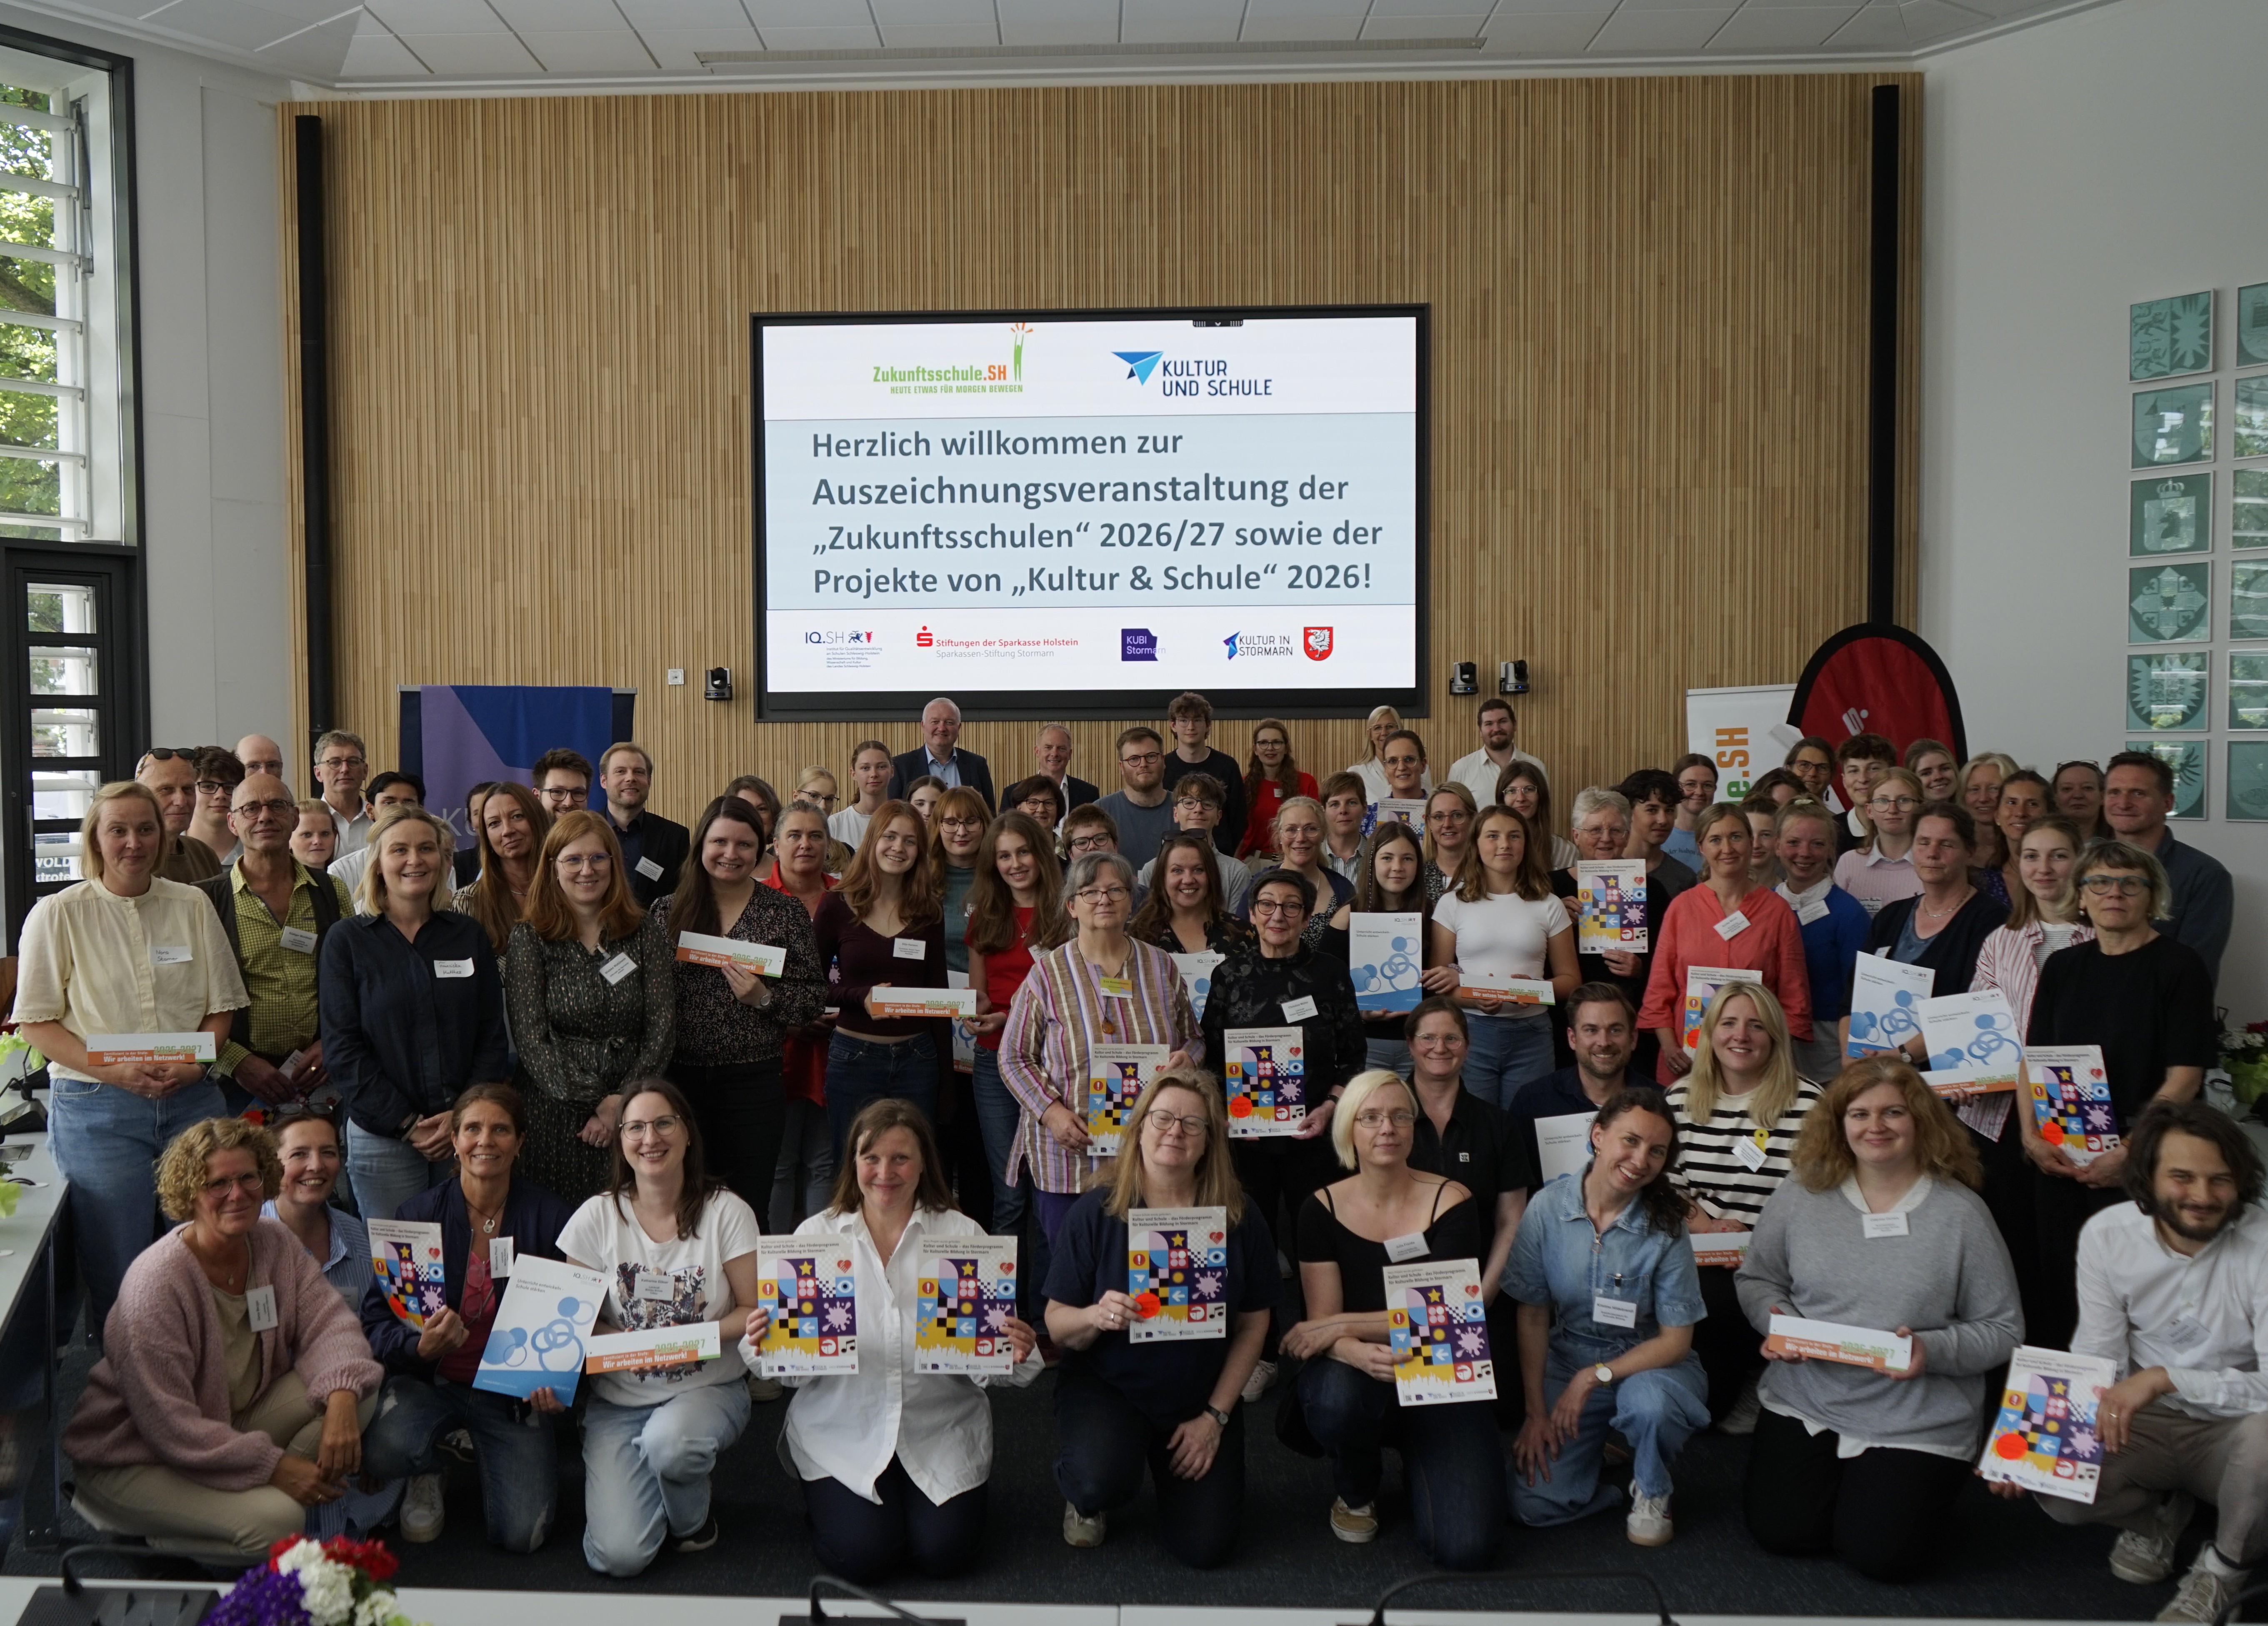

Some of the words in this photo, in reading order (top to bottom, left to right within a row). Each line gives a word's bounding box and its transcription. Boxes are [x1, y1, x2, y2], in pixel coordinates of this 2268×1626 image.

[873, 365, 1006, 382] Zukunftsschule.SH
[1163, 360, 1227, 377] KULTUR
[941, 384, 953, 393] FÜR
[1163, 380, 1199, 397] UND
[1208, 379, 1272, 396] SCHULE
[813, 431, 930, 457] Herzlich
[941, 430, 1126, 455] willkommen
[1137, 434, 1183, 453] zur
[812, 473, 1289, 510] Auszeichnungsveranstaltung
[1299, 475, 1349, 500] der
[813, 522, 1090, 554] „Zukunftsschulen“
[1100, 519, 1225, 552] 2026/27
[1235, 520, 1323, 546] sowie
[1333, 520, 1383, 544] der
[815, 567, 938, 599] Projekte
[948, 574, 1001, 592] von
[1011, 566, 1120, 596] „Kultur
[1130, 565, 1153, 590] &
[1163, 563, 1278, 590] Schule“
[1288, 563, 1370, 589] 2026!
[805, 632, 843, 644] IQ.SH
[936, 639, 980, 648] Stiftungen
[998, 639, 1040, 648] Sparkasse
[1127, 636, 1147, 644] KUBI
[1239, 636, 1274, 645] KULTUR
[1280, 635, 1290, 644] IN
[936, 650, 1015, 659] Sparkassen-Stiftung
[1126, 646, 1165, 654] Stormarn
[1239, 647, 1293, 655] STORMARN
[731, 953, 772, 967] 2026-2027
[925, 1000, 965, 1009] 2026-2027
[154, 1045, 202, 1054] 2026-2027
[655, 1339, 705, 1355] 2026-2027
[1785, 1342, 1798, 1351] Wir
[1798, 1346, 1827, 1356] arbeiten
[617, 1358, 643, 1367] arbeiten
[655, 1351, 687, 1362] Netzwerk!
